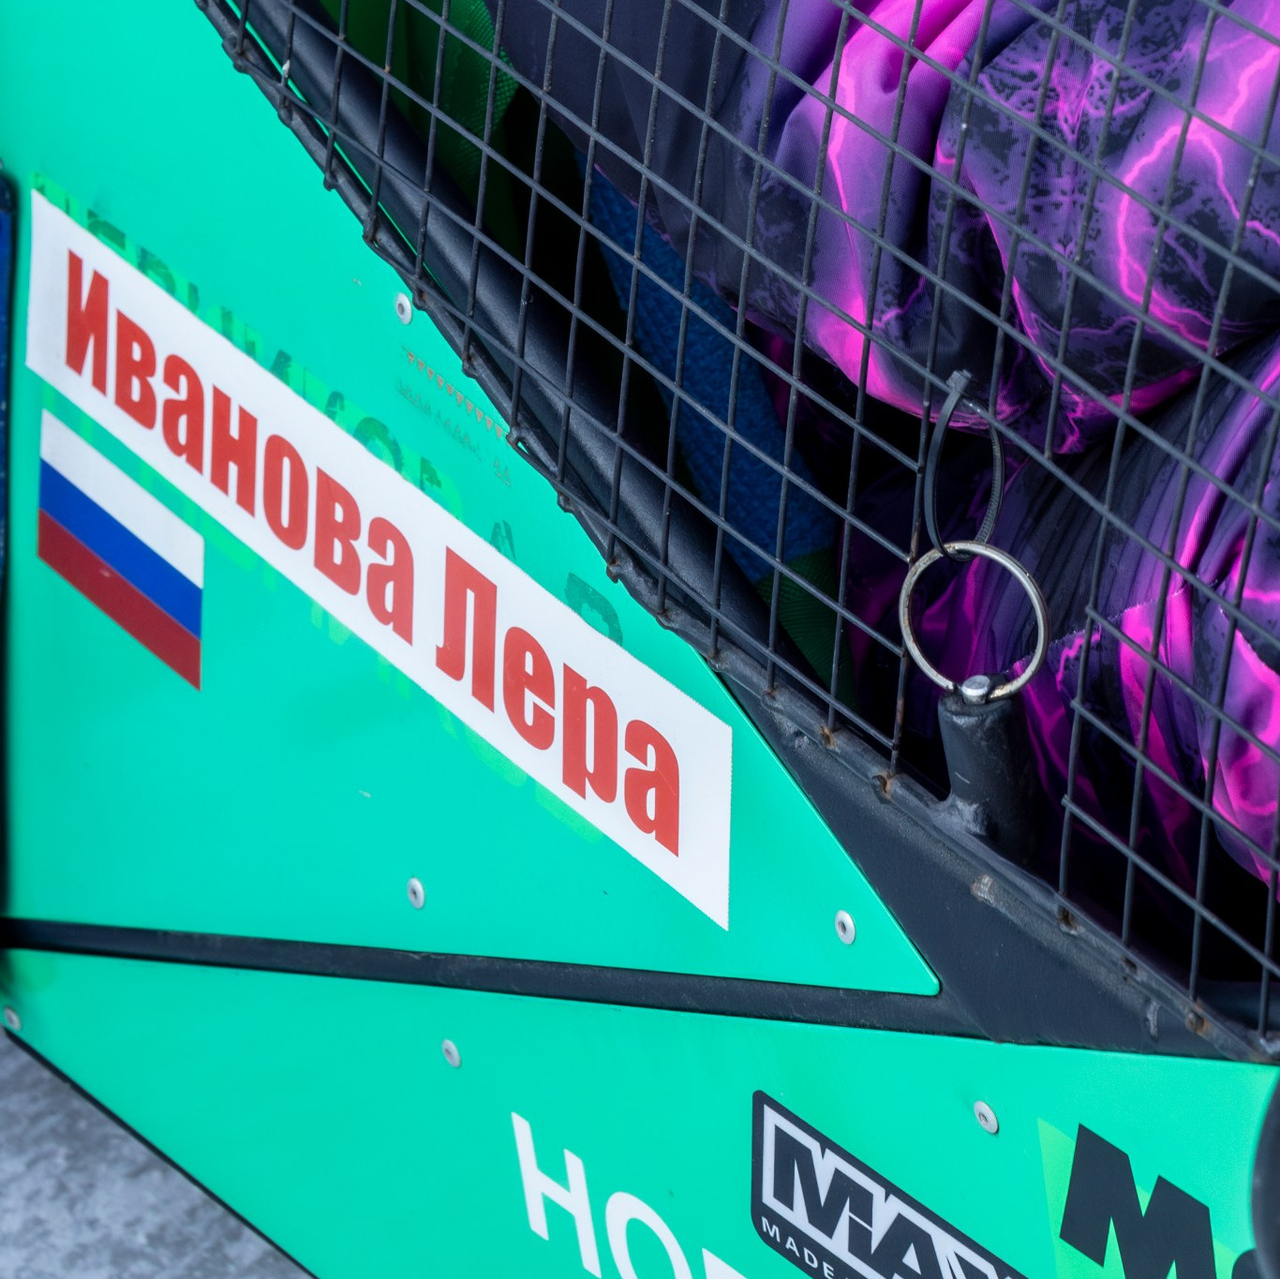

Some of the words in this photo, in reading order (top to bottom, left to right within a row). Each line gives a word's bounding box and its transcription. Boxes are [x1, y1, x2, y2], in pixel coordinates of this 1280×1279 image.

[65, 249, 414, 646] Иванова
[435, 546, 680, 857] Лера
[511, 1111, 755, 1279] НО
